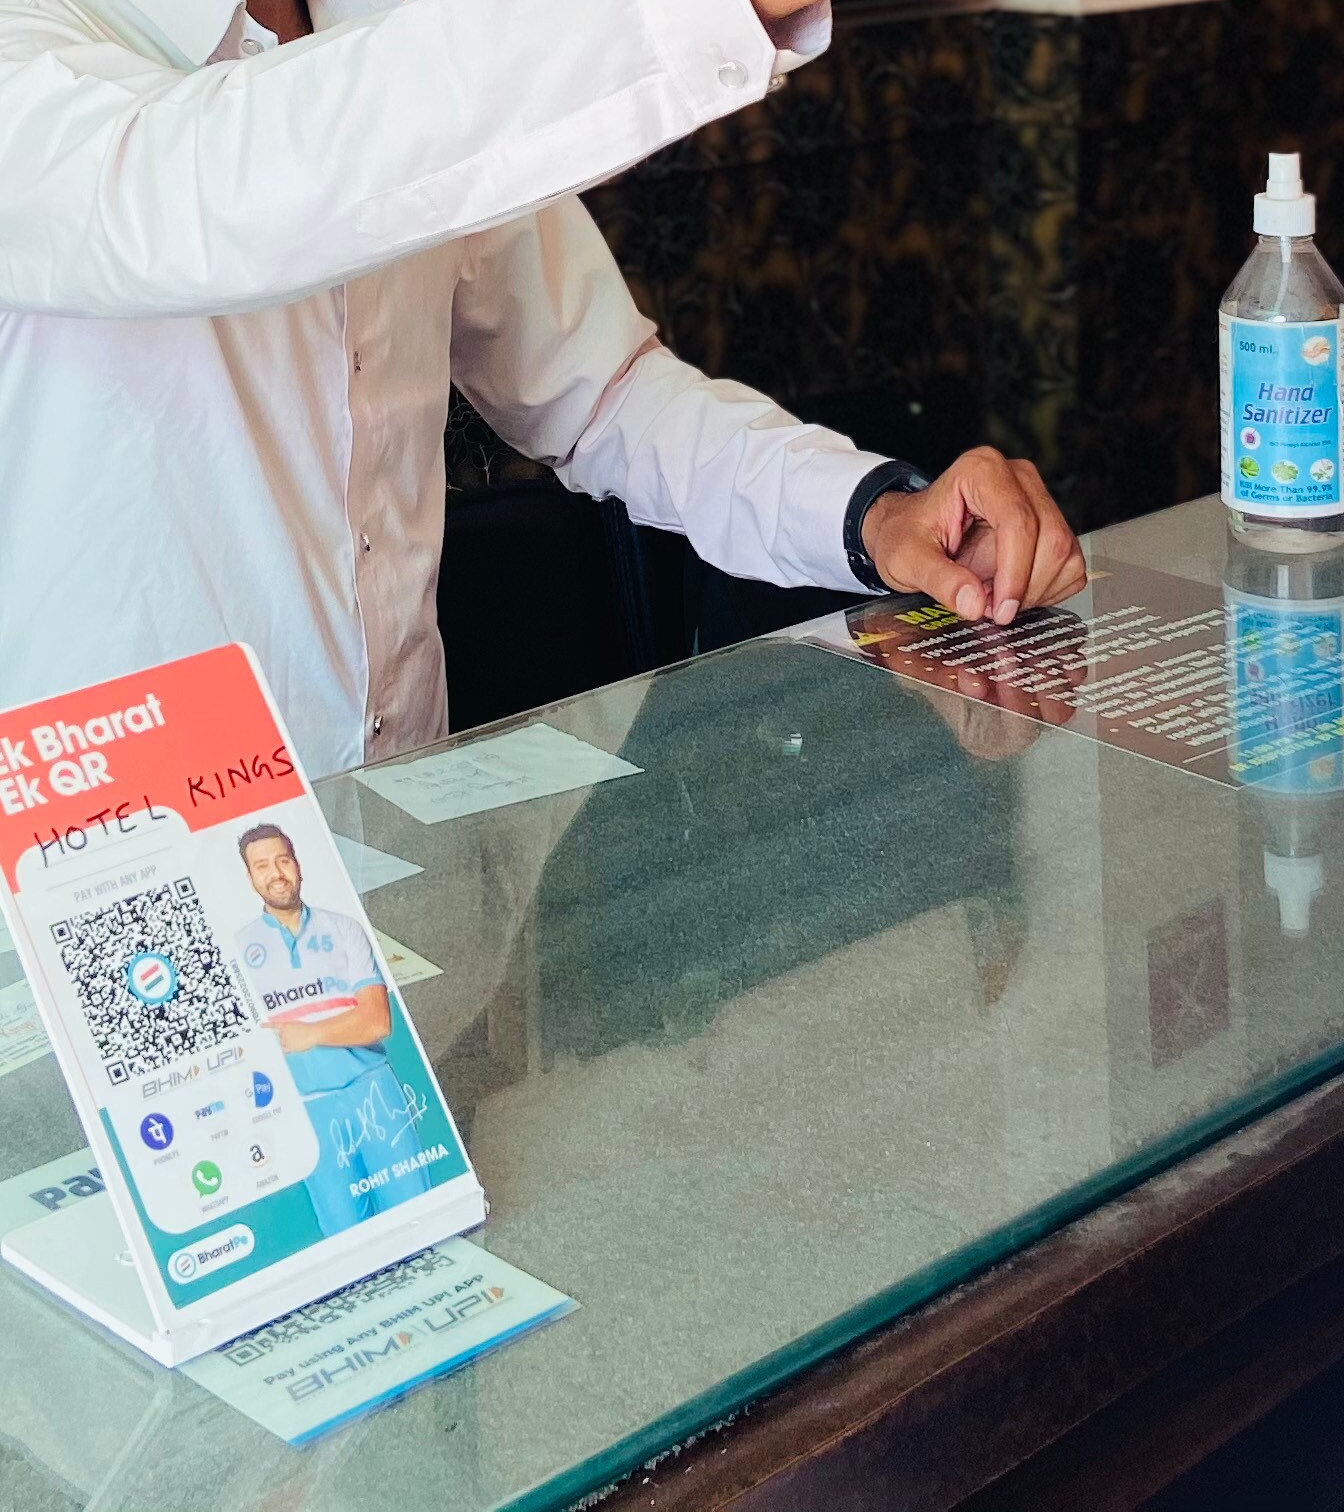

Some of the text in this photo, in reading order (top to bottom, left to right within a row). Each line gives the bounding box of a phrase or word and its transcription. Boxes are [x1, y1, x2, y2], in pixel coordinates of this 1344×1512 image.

[1239, 341, 1256, 352] 500
[1258, 383, 1314, 402] Hand
[1243, 404, 1332, 425] Sanitizer
[1254, 482, 1276, 493] More
[1281, 483, 1304, 494] Than
[1296, 492, 1333, 502] Bacteria
[30, 692, 166, 762] Bharat
[49, 751, 115, 796] QR
[33, 745, 294, 868] HOTEL KINGS
[73, 865, 157, 903] PAY WITH ANY APP
[307, 935, 334, 953] 45
[142, 1047, 239, 1099] BHIM UPI
[349, 1143, 449, 1198] ROHIT SHARMA
[197, 1235, 248, 1265] BharatPe
[263, 1367, 295, 1385] Pay
[299, 1344, 345, 1369] using
[379, 1305, 423, 1329] BHIM
[422, 1290, 452, 1307] UPI
[454, 1274, 485, 1292] APP
[286, 1289, 494, 1402] BHIM UPI
